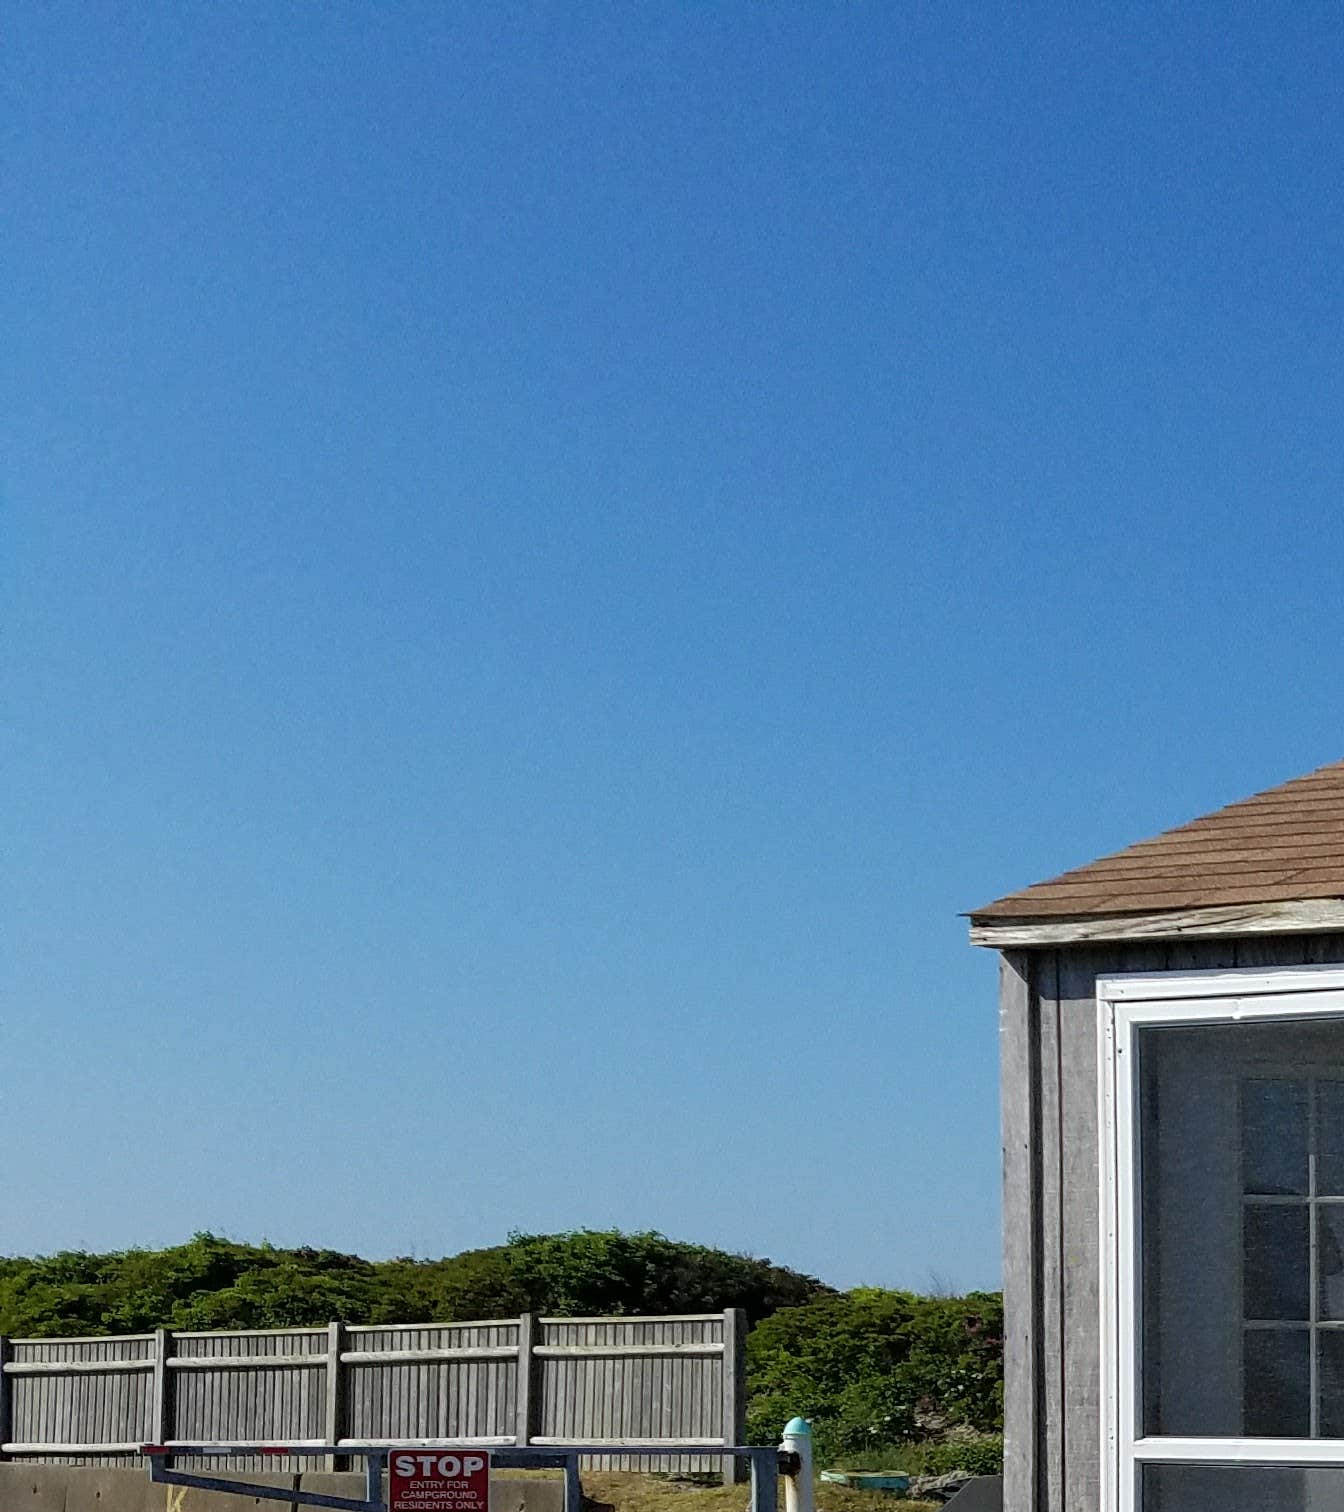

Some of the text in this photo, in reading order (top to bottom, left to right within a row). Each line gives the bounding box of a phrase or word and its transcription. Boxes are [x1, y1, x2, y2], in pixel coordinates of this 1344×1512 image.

[395, 1455, 484, 1477] STOP
[409, 1480, 469, 1489] ENTRY FOR
[401, 1491, 478, 1499] CAMPGROUND
[394, 1501, 485, 1510] RESIDENTS ONLY
